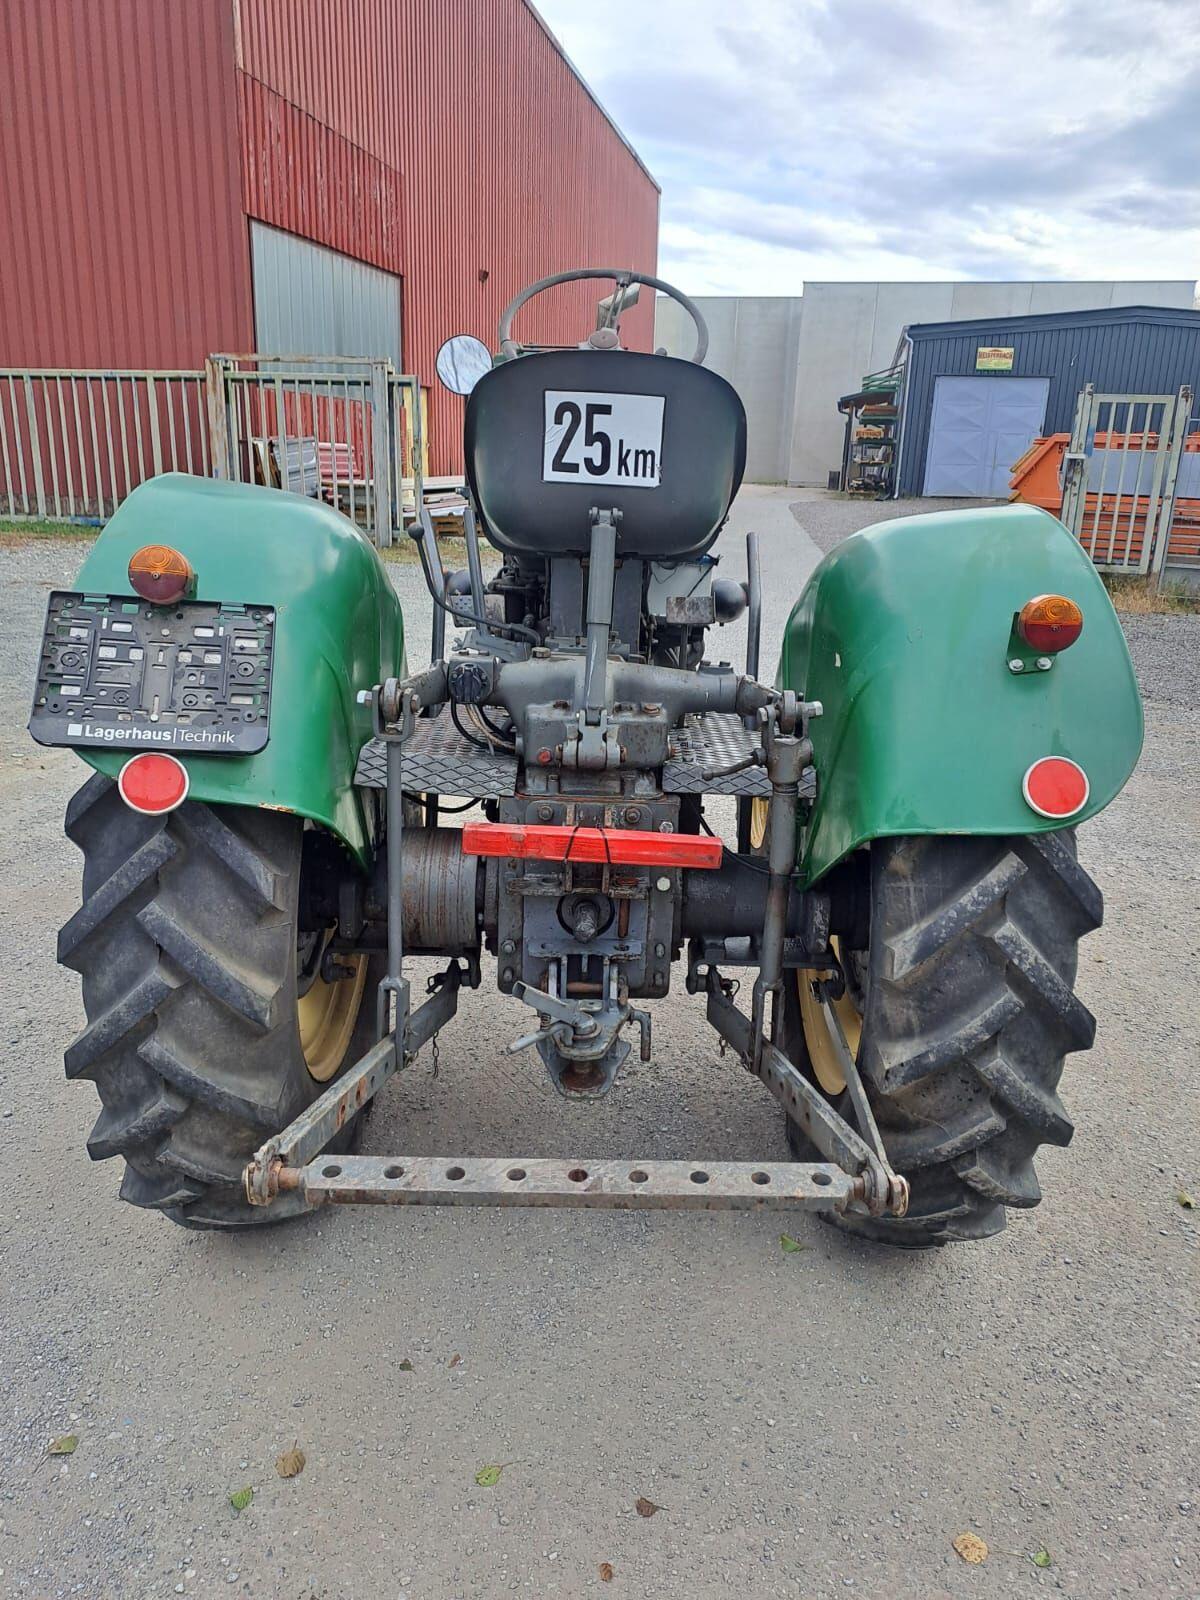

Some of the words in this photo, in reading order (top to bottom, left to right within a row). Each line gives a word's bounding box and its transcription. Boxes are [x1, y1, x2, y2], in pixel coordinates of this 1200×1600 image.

[552, 401, 612, 477] 25
[617, 438, 656, 479] km
[85, 724, 172, 742] Lagerhaus
[178, 729, 235, 743] Technik
